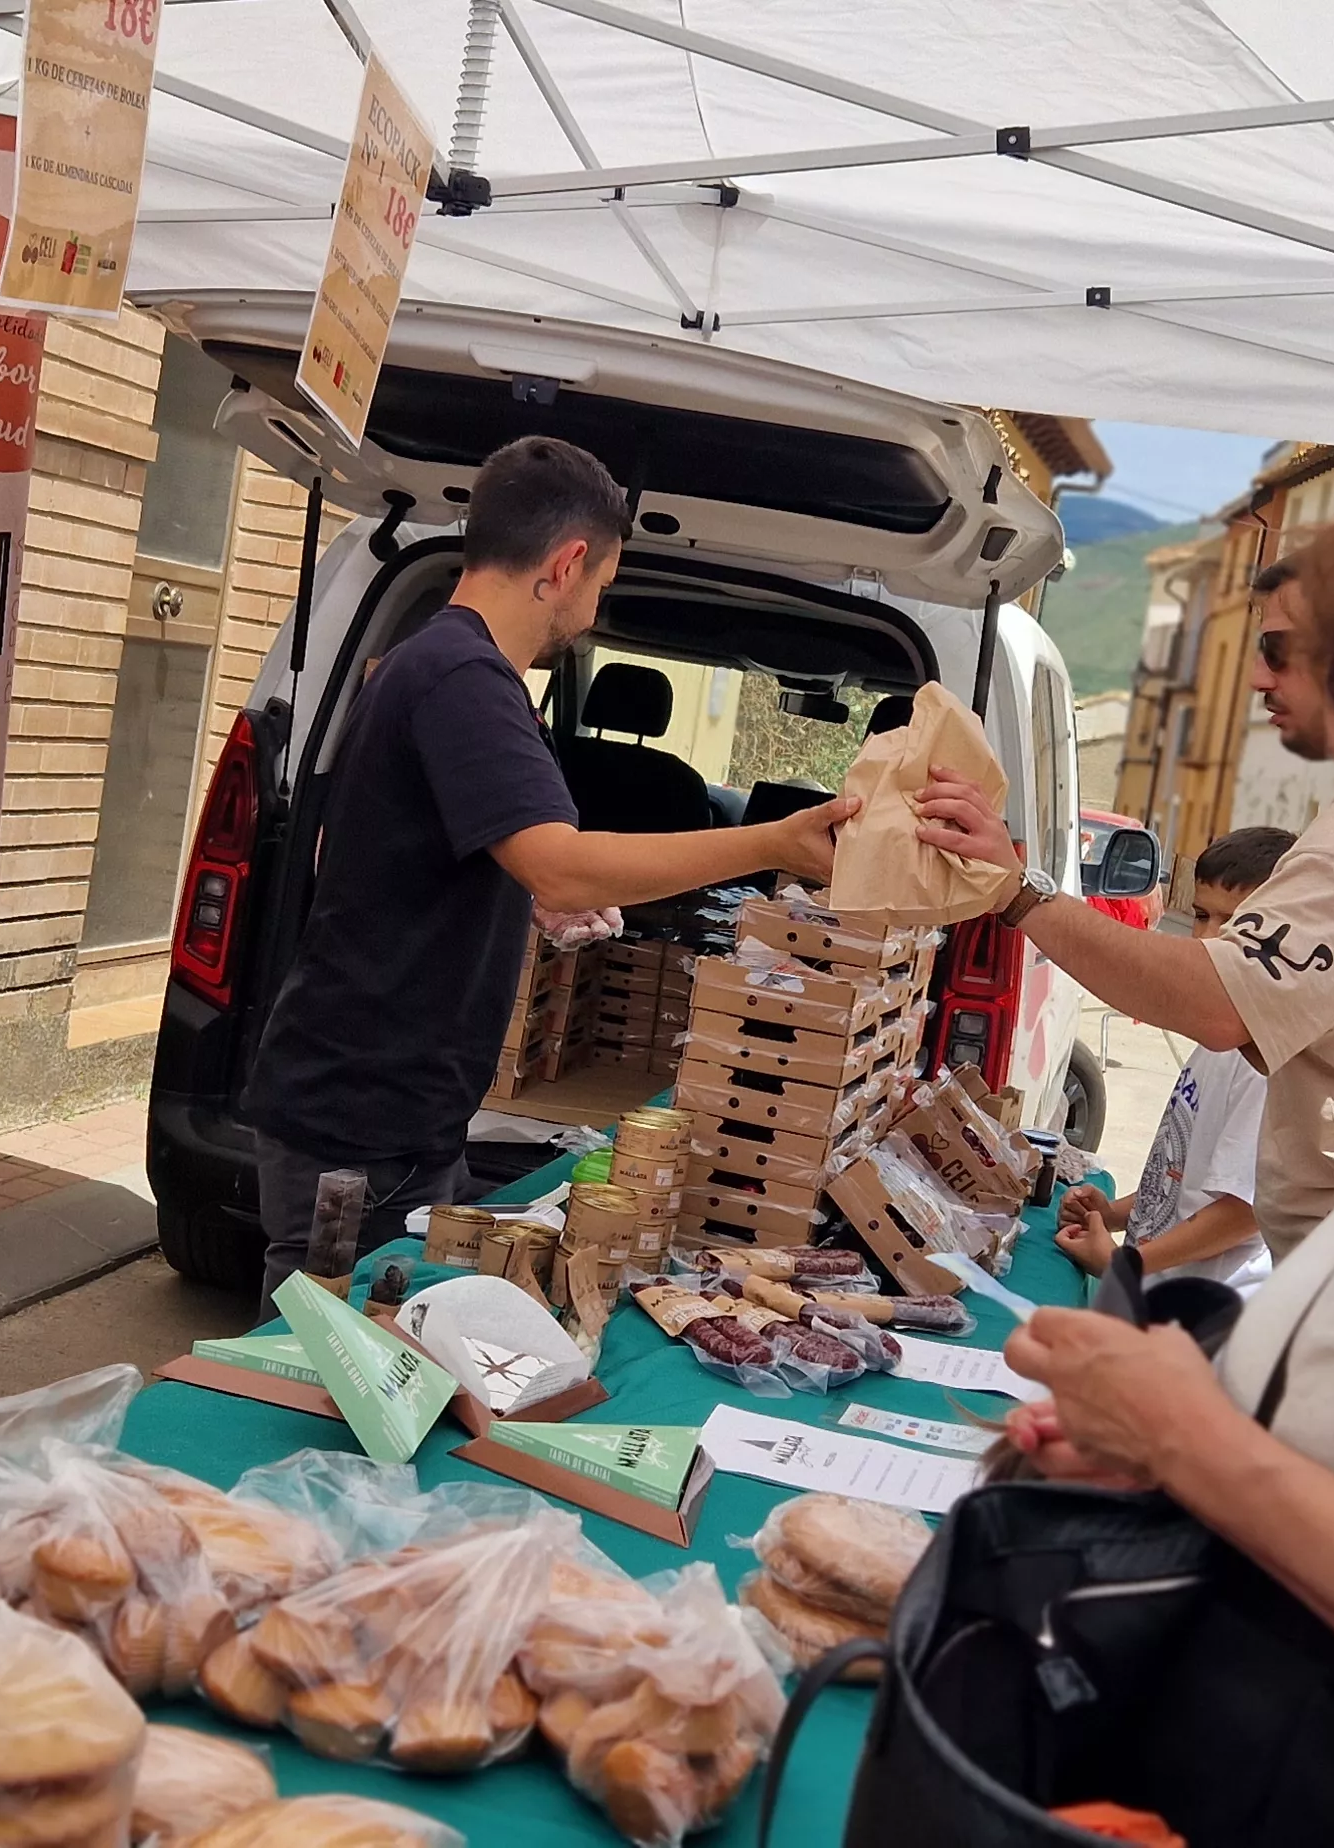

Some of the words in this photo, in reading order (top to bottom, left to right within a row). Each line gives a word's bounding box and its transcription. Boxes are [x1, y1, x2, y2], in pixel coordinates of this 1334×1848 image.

[104, 0, 156, 45] 18€
[35, 58, 49, 77] KG
[51, 63, 65, 82] DE
[66, 68, 105, 96] CEREZAS
[107, 83, 118, 101] DE
[120, 87, 146, 110] BOLEA
[368, 93, 421, 188] ECOPACK
[31, 155, 42, 171] KG
[43, 158, 54, 174] DE
[384, 186, 415, 249] 18€
[326, 1331, 345, 1358] TARTA
[341, 1354, 353, 1369] DE
[377, 1349, 422, 1401] MALLATA
[572, 1457, 582, 1471] DE
[615, 1427, 653, 1469] MALLATA
[771, 1434, 804, 1466] MALLATA
